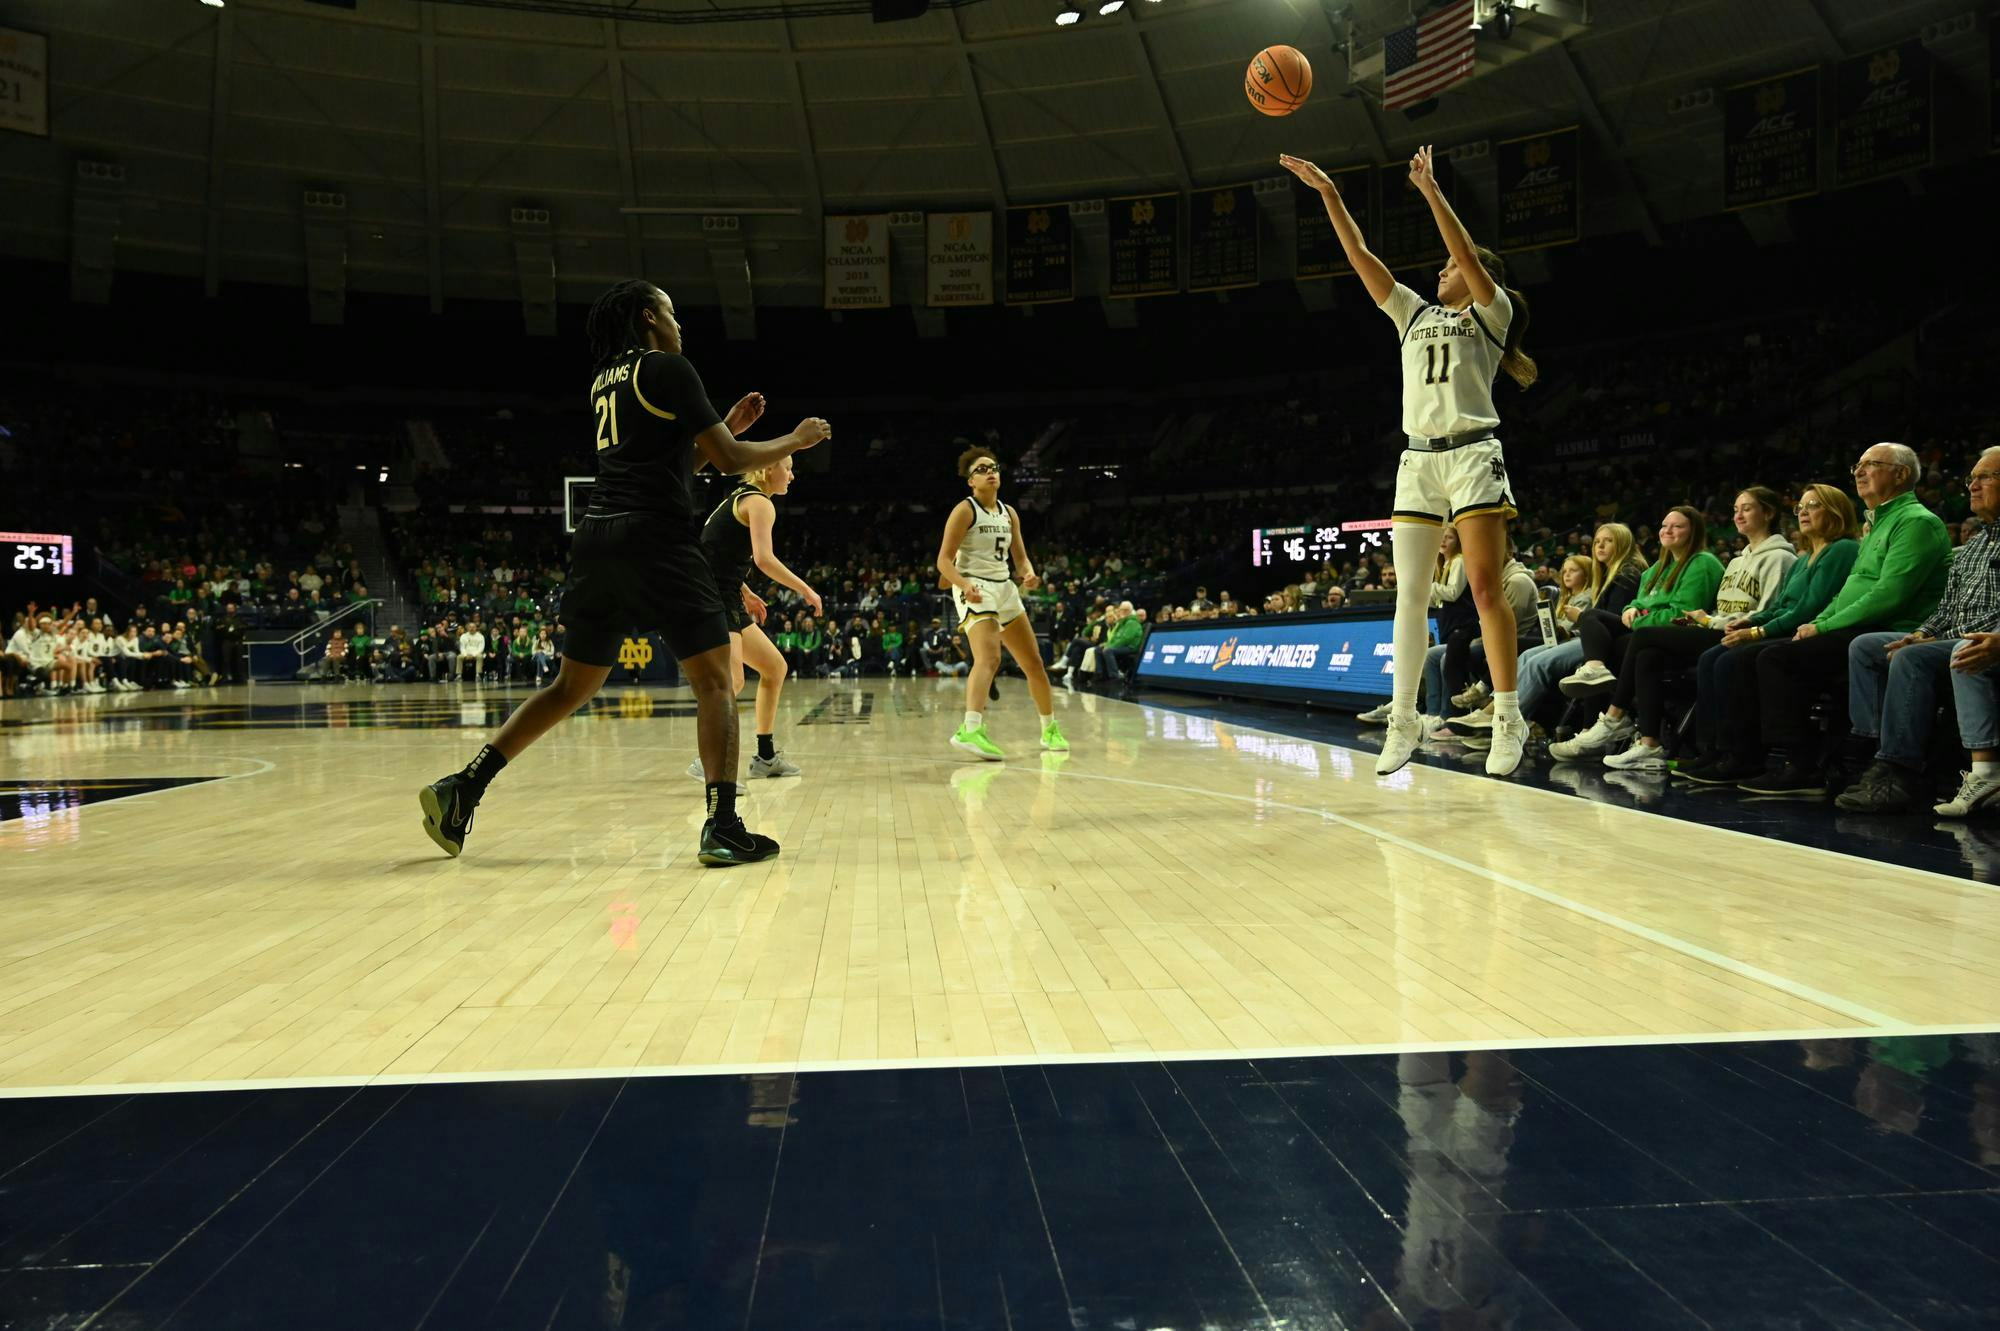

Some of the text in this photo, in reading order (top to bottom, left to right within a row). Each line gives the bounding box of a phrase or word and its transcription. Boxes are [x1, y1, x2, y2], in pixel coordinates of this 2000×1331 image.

[840, 246, 873, 256] NCAA
[943, 243, 976, 252] NCAA
[827, 256, 886, 266] CHAMPION
[930, 254, 990, 264] CHAMPION
[948, 269, 972, 278] 2001
[1443, 326, 1475, 338] DAME
[1426, 343, 1450, 385] 11
[595, 390, 619, 451] 21
[1619, 432, 1656, 449] EMMA
[979, 525, 1001, 534] NOTRE
[1266, 526, 1305, 536] NOTRE DAME
[994, 537, 1006, 562] 5
[1283, 537, 1306, 561] 46
[14, 545, 45, 570] 25
[1185, 645, 1207, 664] INVEST
[1231, 643, 1320, 669] STUDENT-ATHLETES
